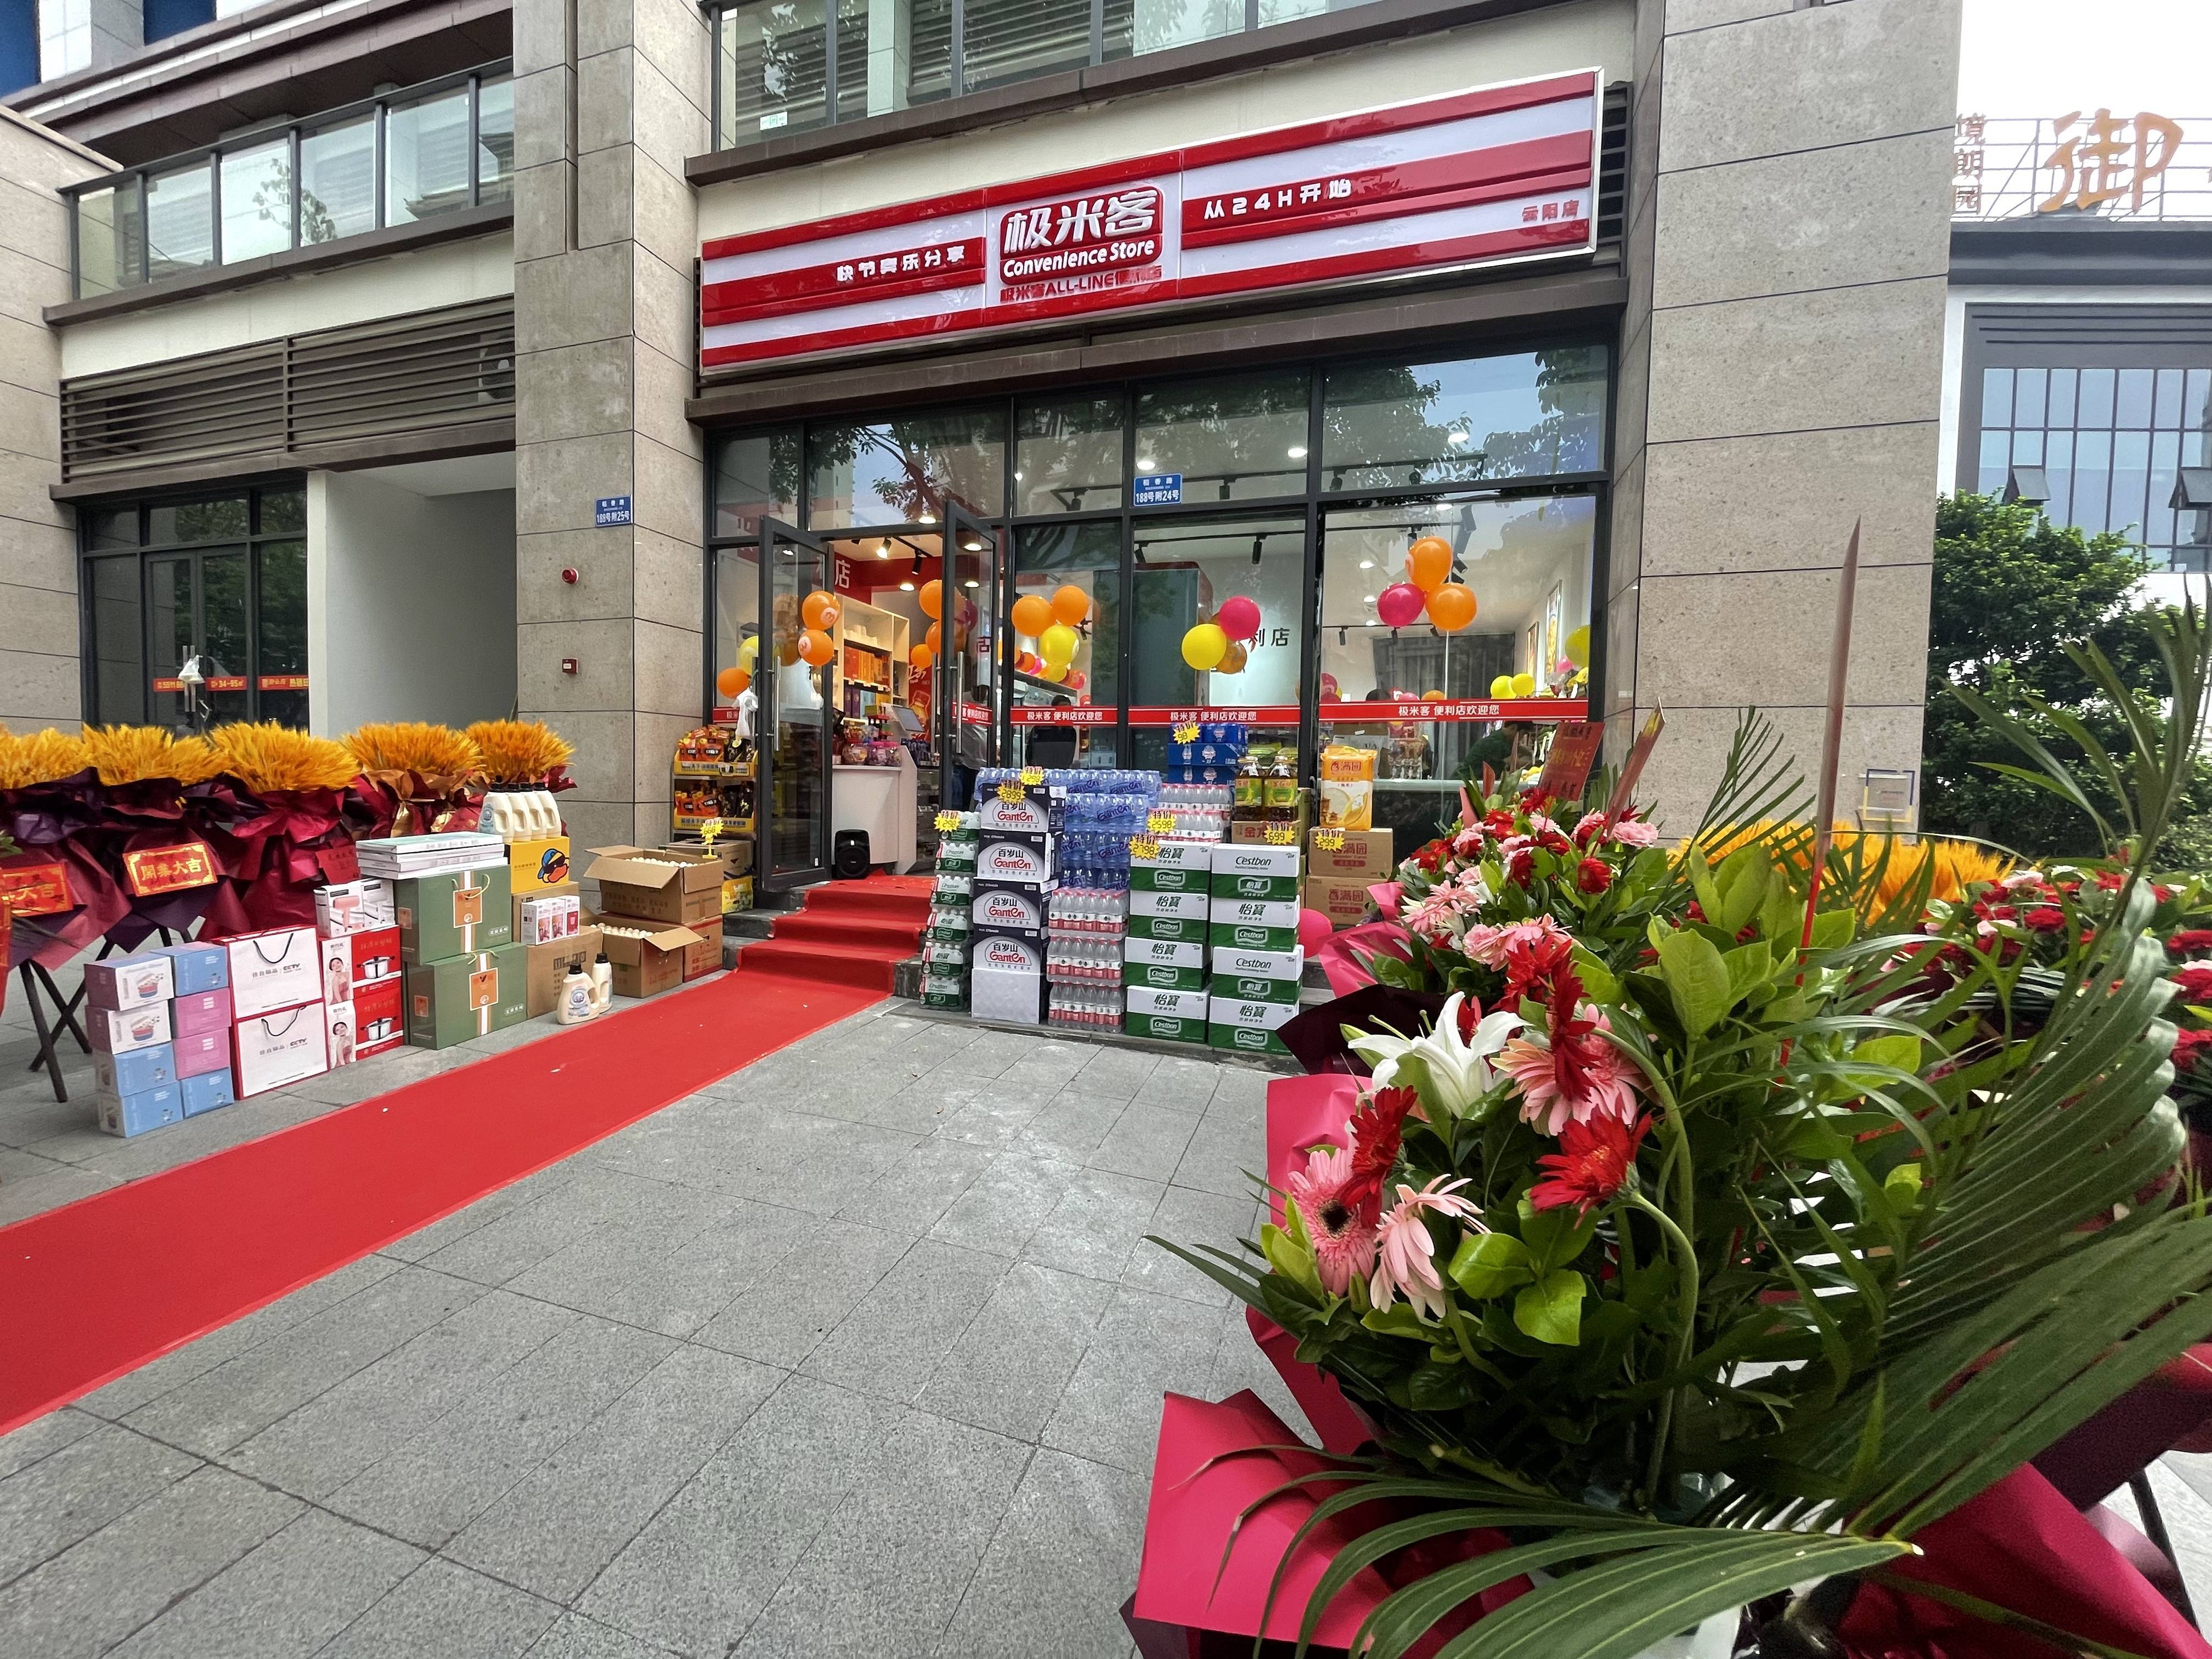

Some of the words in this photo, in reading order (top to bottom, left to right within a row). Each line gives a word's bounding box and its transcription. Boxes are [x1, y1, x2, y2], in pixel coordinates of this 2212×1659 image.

[1003, 189, 1159, 254] 极米客
[1003, 247, 1107, 278] Convenience
[1109, 239, 1155, 261] Store
[1398, 706, 1430, 716] 极米客
[1434, 704, 1500, 716] 便利店欢迎您
[1027, 711, 1052, 721] 极米客
[1053, 711, 1103, 721] 便利店欢迎您
[1170, 712, 1198, 722] 极米客
[1200, 711, 1257, 722] 便利店欢迎您
[997, 811, 1034, 822] Ganten
[998, 849, 1024, 858] 百岁山
[994, 857, 1031, 870] Ganten
[992, 897, 1017, 907] 百岁山
[989, 906, 1024, 918] Ganten
[993, 943, 1018, 952] 百岁山
[990, 951, 1025, 963] Ganten
